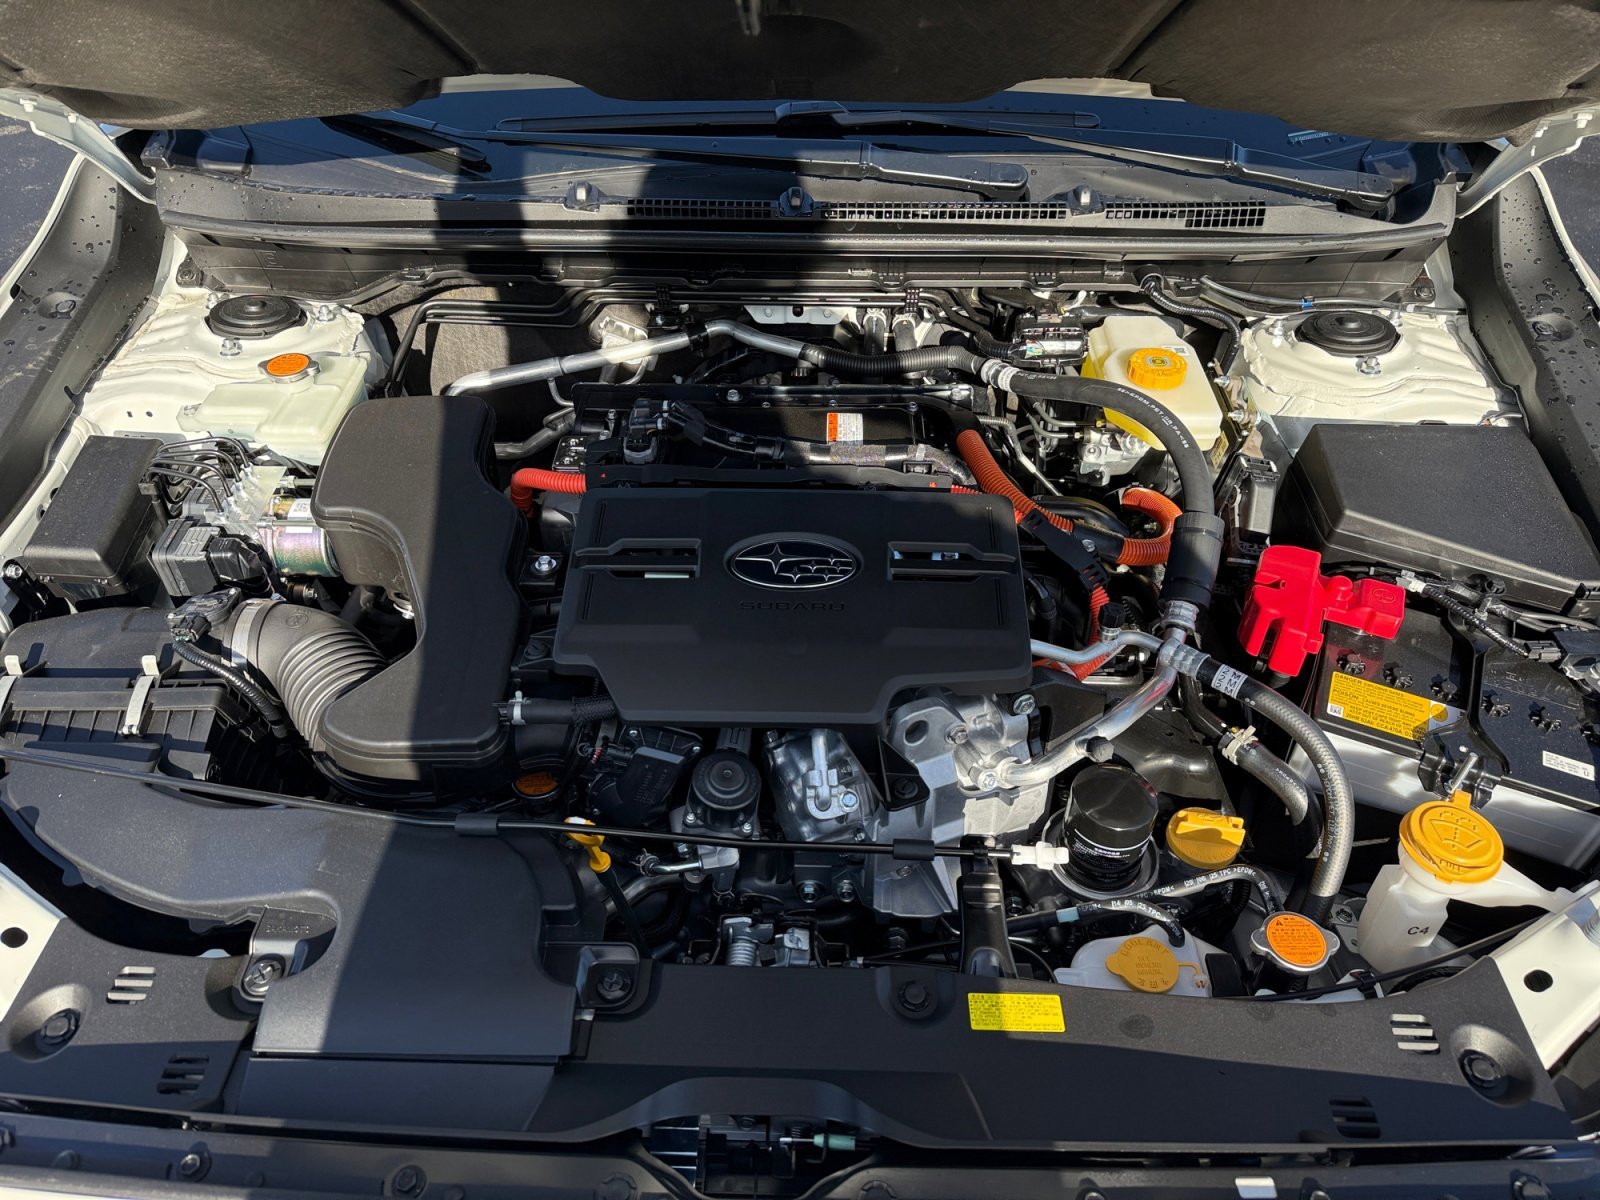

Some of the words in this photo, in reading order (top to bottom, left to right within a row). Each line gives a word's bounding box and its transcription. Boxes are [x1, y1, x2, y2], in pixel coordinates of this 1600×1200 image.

[740, 601, 845, 611] SUBARU
[1334, 674, 1362, 684] DANGER
[1332, 690, 1358, 699] POISON
[1362, 698, 1380, 706] CAUSES
[1380, 703, 1398, 711] SEVERE
[1407, 926, 1430, 935] C4
